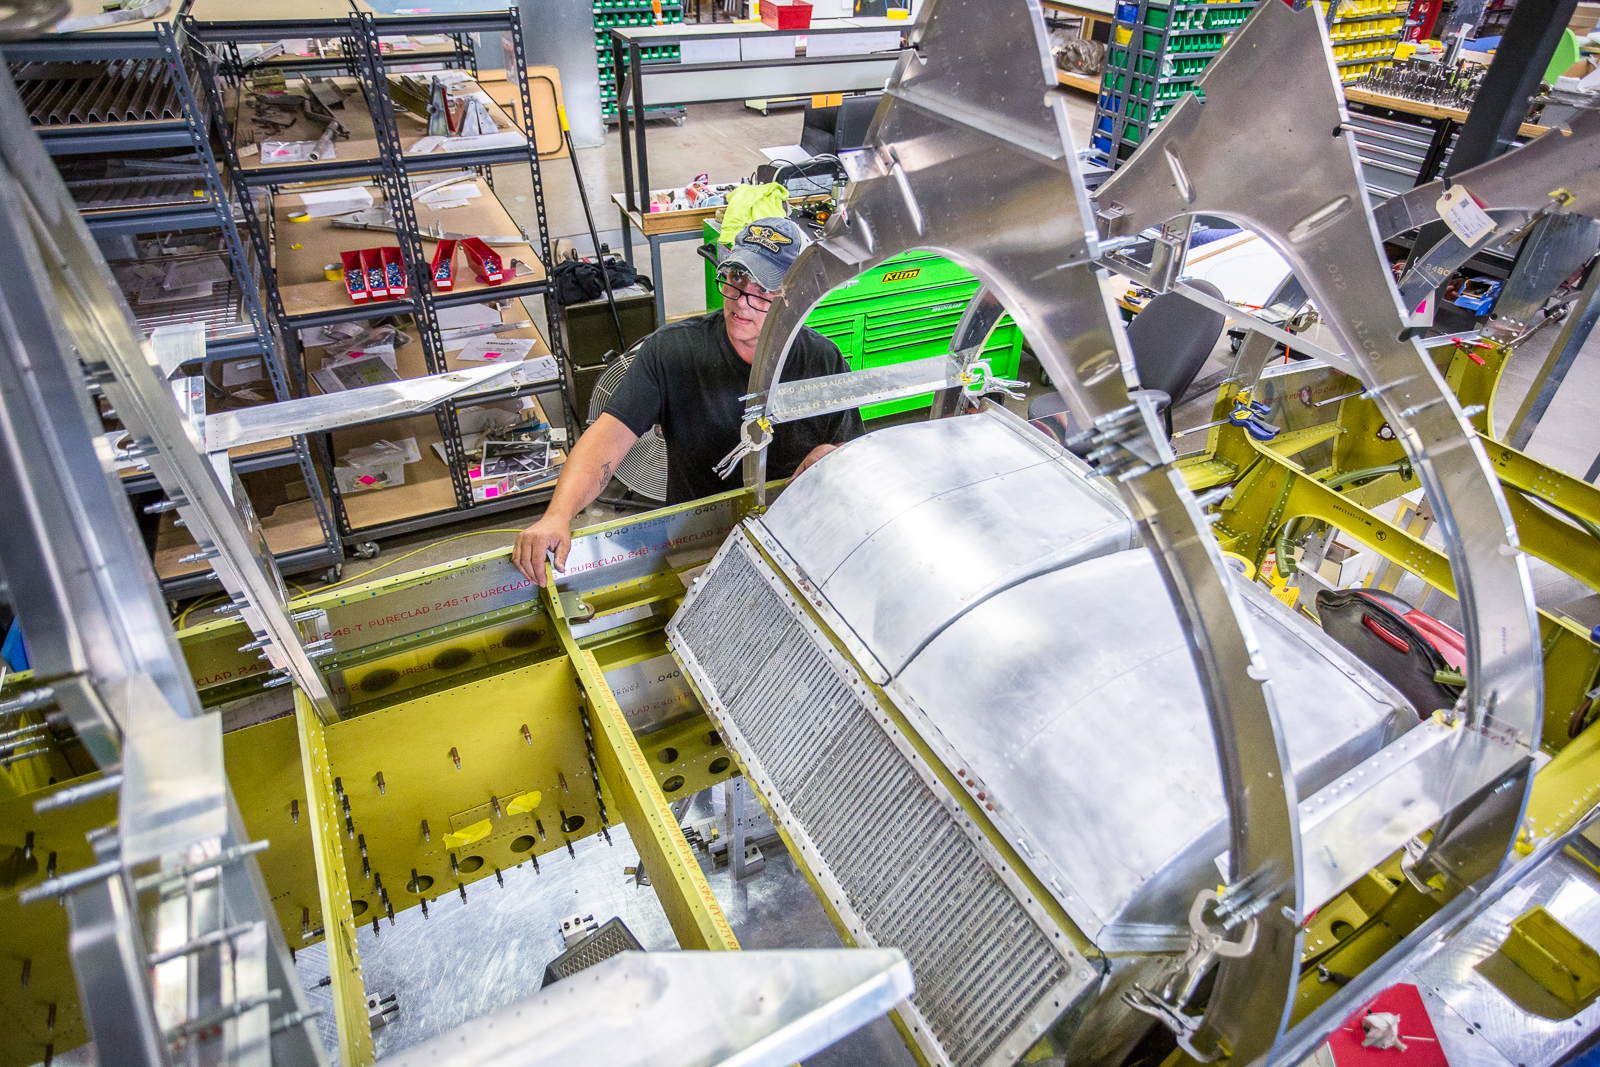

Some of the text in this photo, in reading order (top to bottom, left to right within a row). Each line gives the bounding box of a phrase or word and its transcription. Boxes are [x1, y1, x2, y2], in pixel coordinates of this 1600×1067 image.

[931, 302, 964, 313] DUNLOP
[829, 376, 858, 387] ALCLAD
[776, 402, 820, 415] ALCLAD
[323, 624, 362, 640] 24S-T
[368, 606, 430, 628] PURECLAD
[434, 595, 470, 611] 24S-T
[472, 579, 531, 601] PURECLAD
[570, 554, 625, 574] PURECLAD
[661, 530, 714, 550] PURECLAD
[390, 658, 450, 678] PURECLAD
[656, 670, 680, 683] .040
[693, 873, 714, 903] 24S-T
